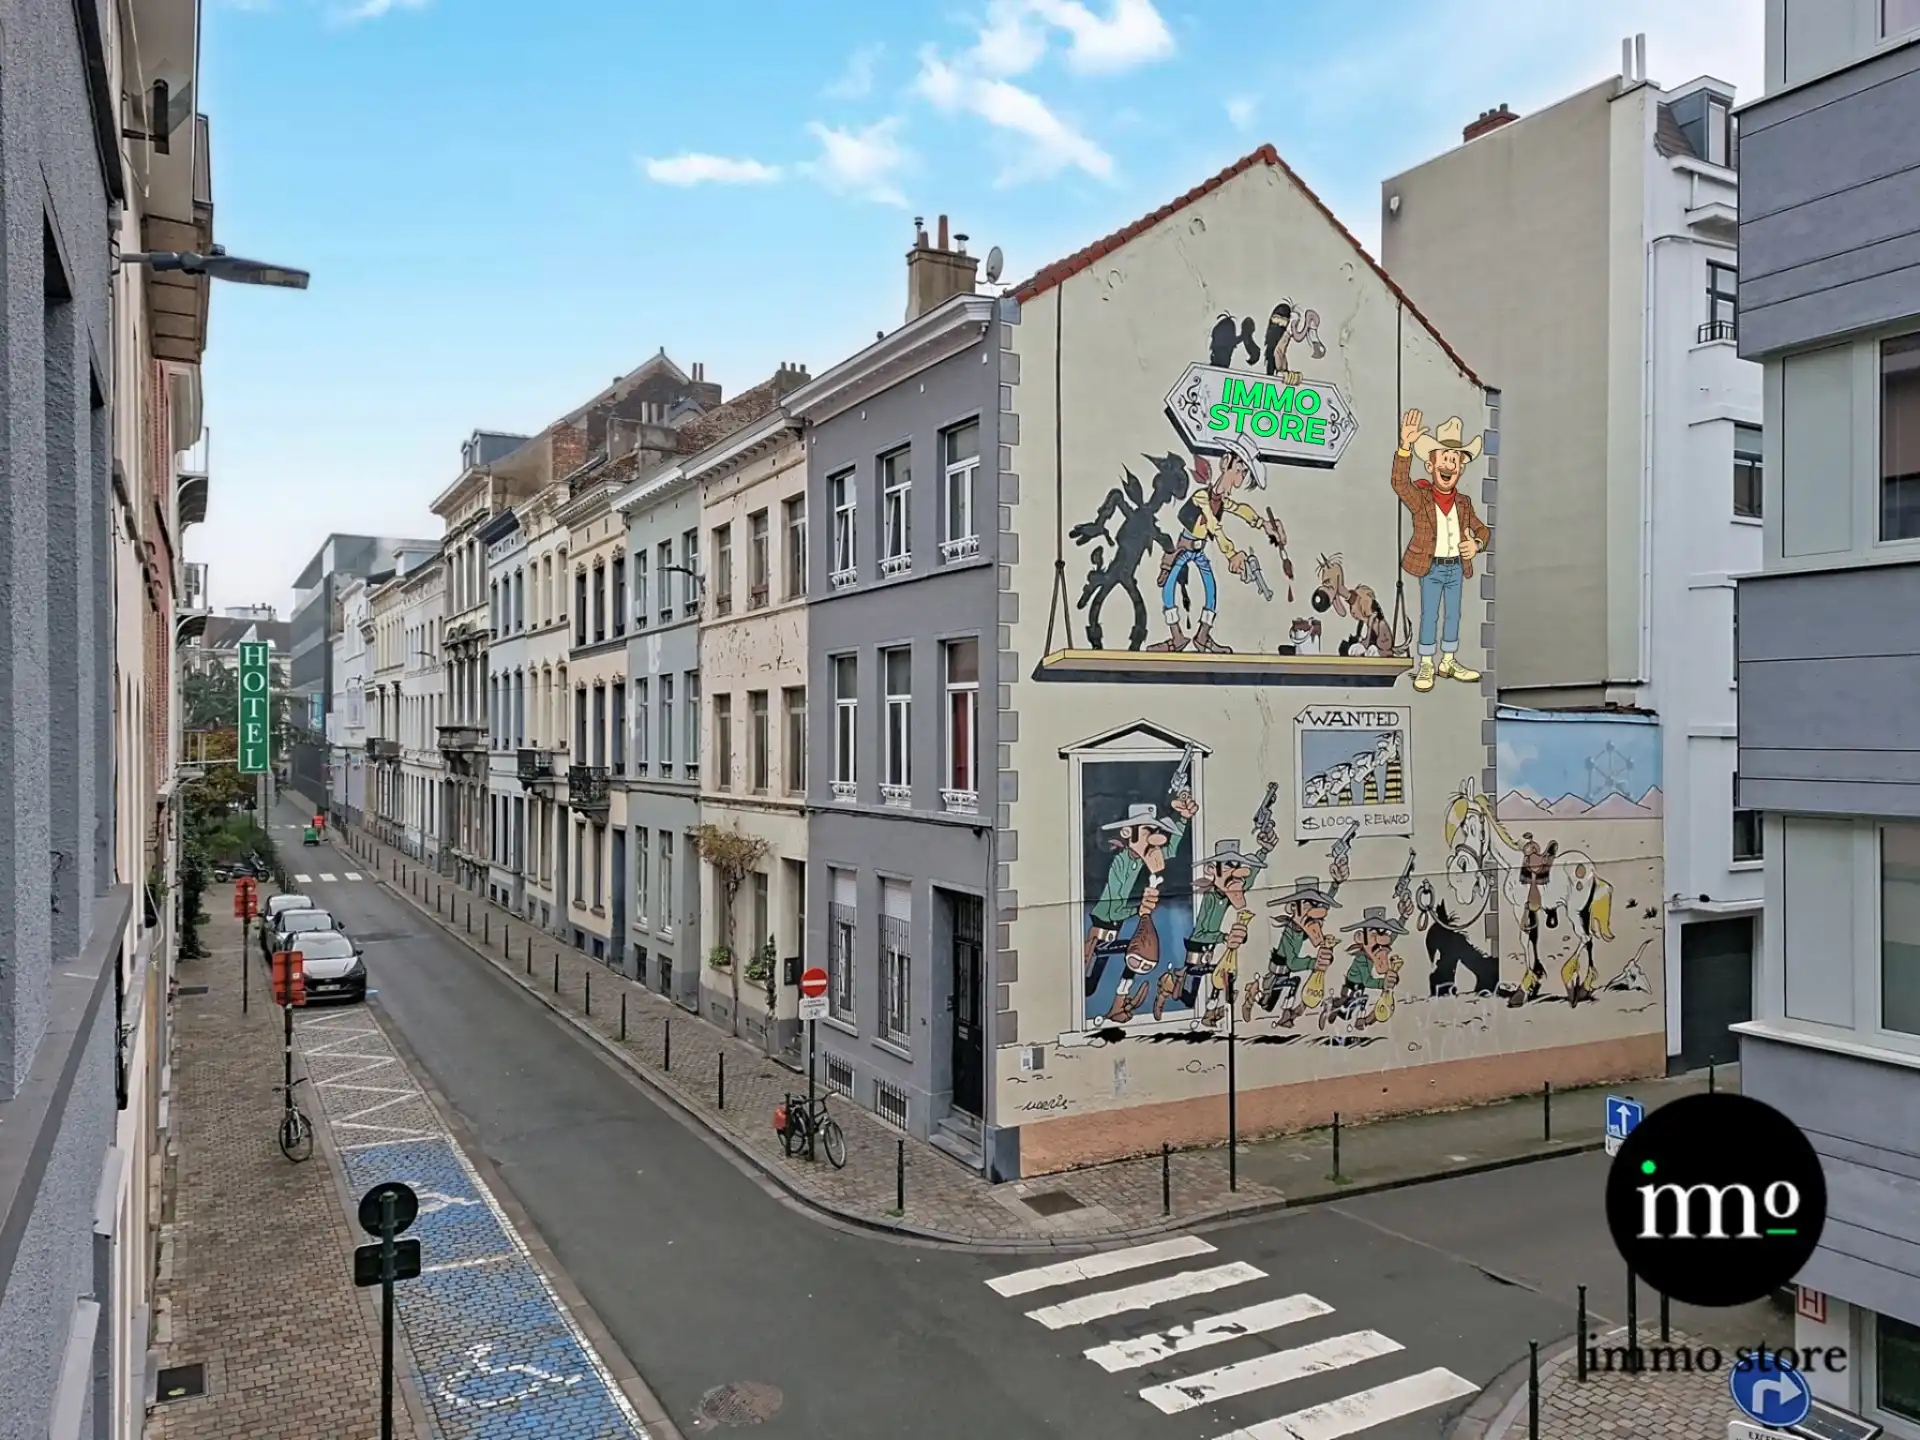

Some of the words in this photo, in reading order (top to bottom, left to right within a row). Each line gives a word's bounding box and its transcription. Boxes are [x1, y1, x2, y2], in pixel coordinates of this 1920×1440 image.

[243, 645, 265, 769] HOTEL
[1306, 711, 1399, 727] WANTED
[1364, 813, 1410, 826] REWARD
